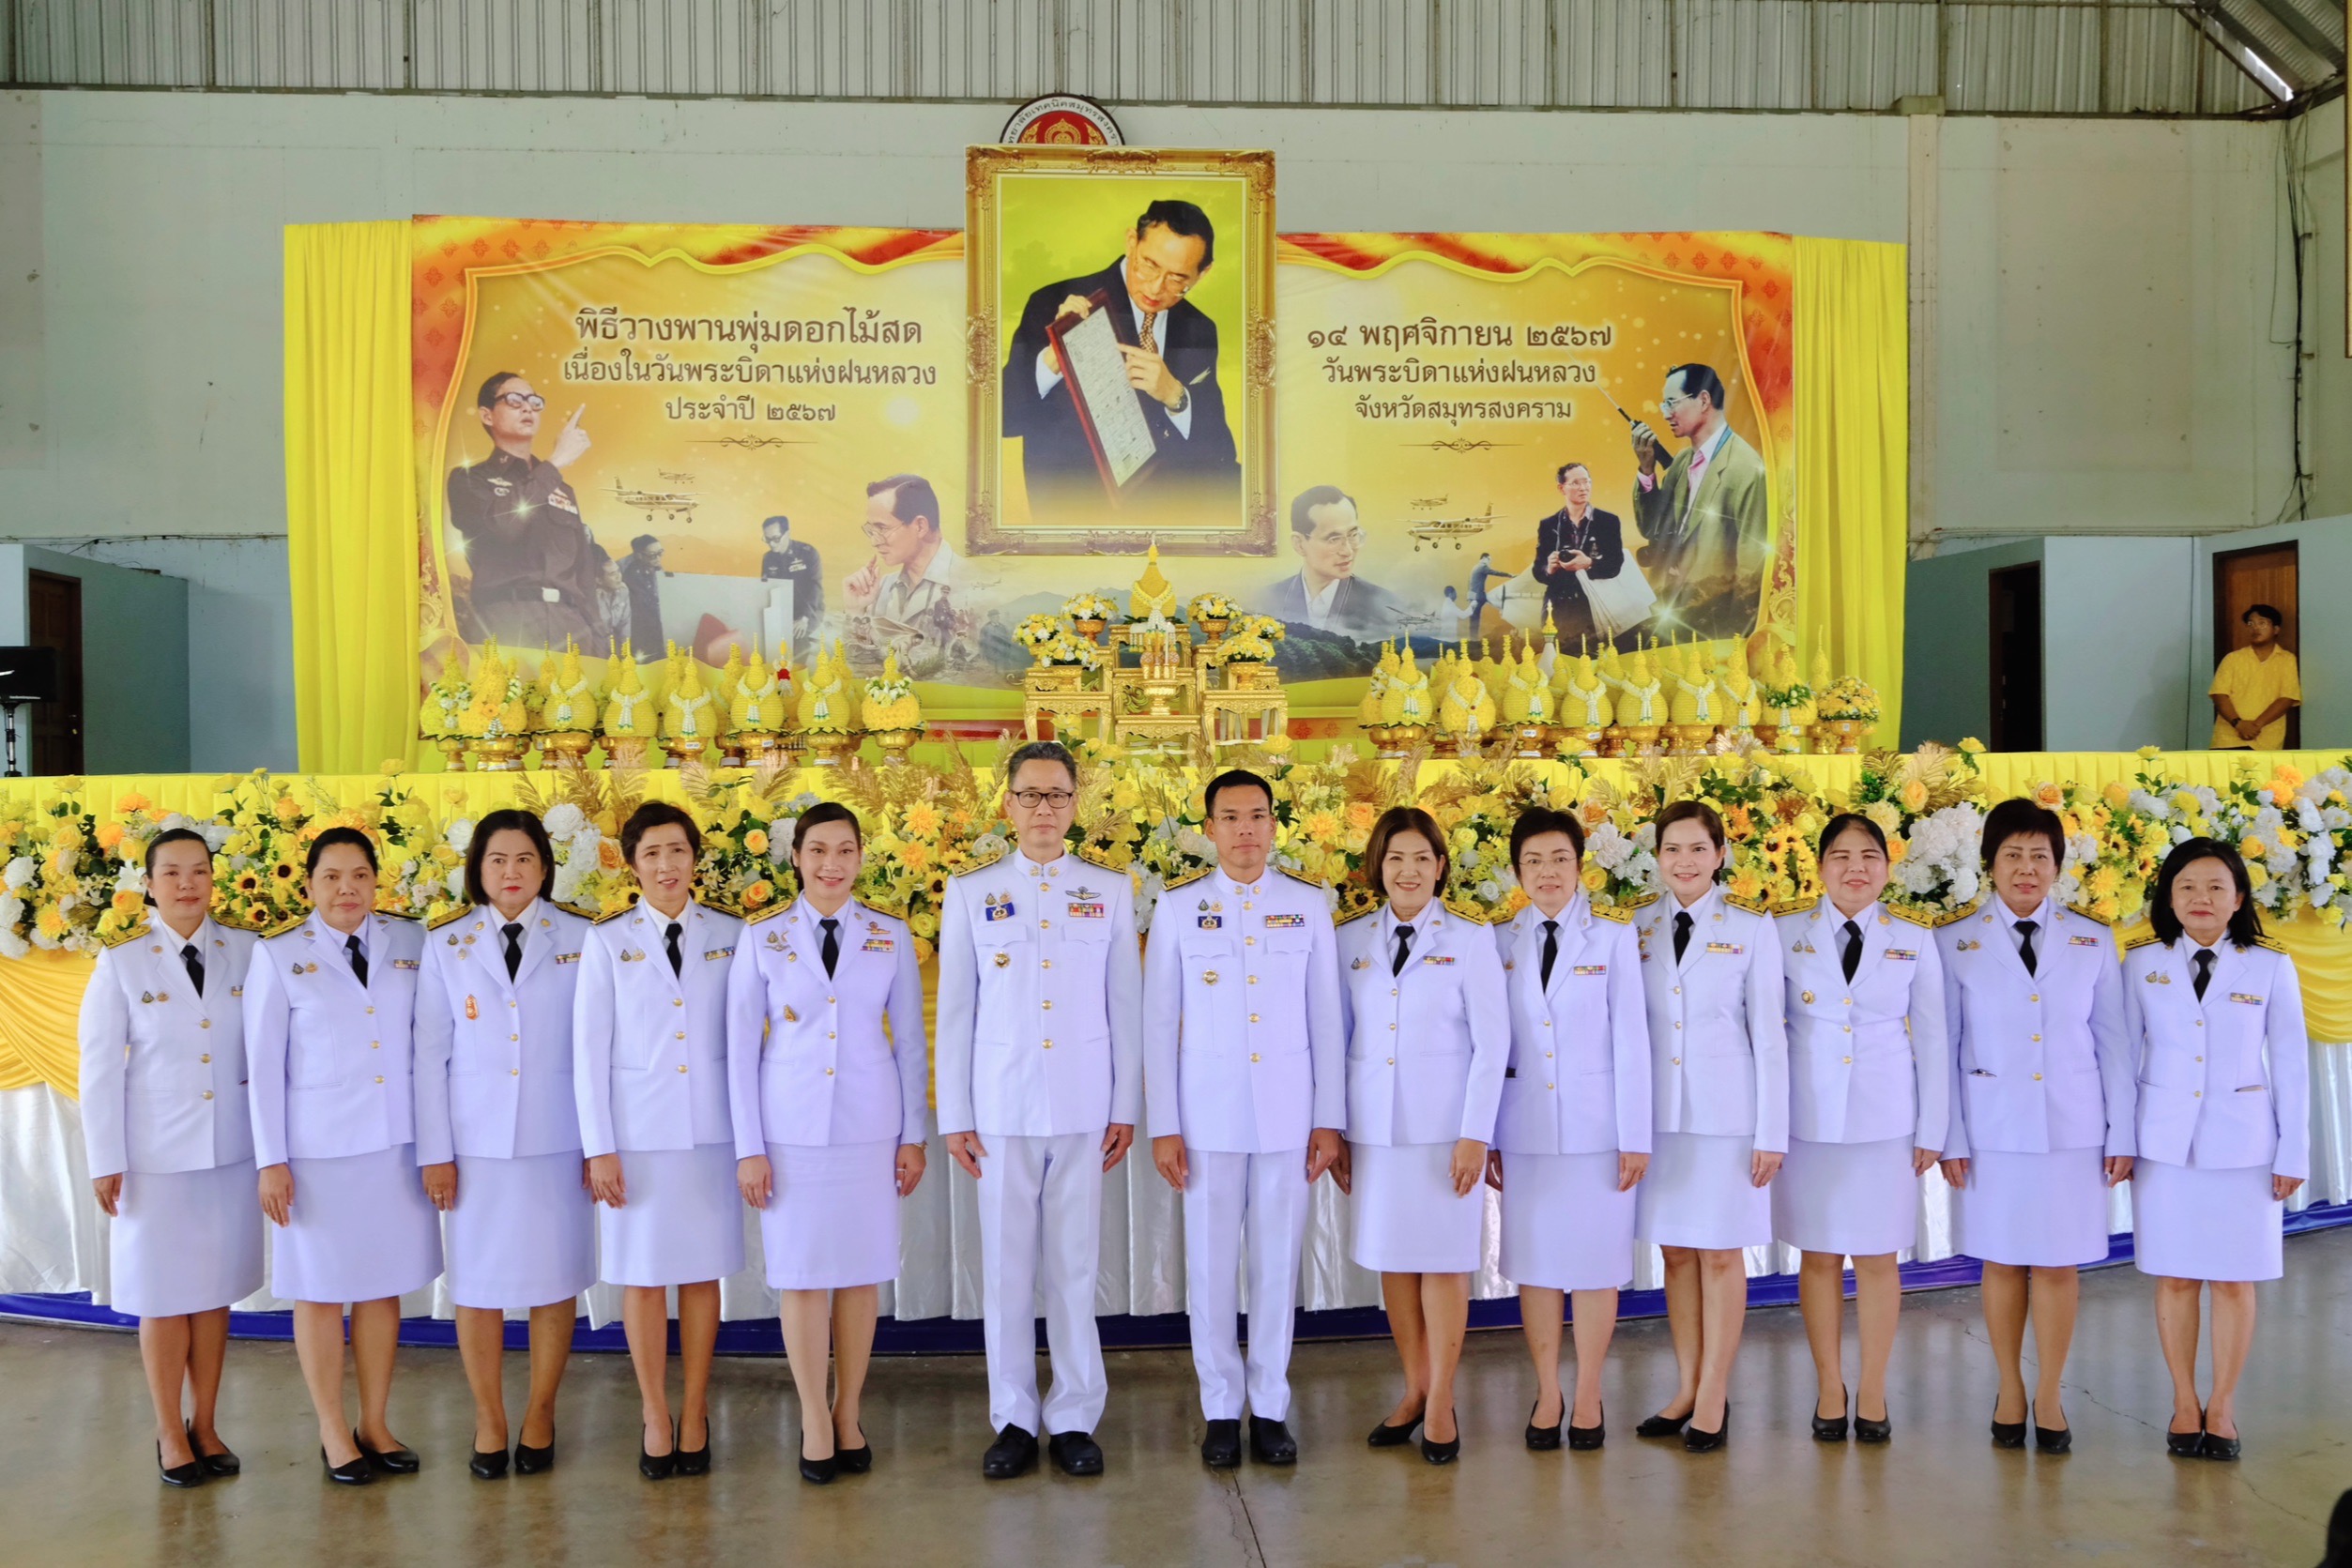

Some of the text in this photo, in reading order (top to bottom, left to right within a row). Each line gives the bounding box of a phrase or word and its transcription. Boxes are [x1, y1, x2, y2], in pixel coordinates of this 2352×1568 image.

[574, 307, 923, 354] พิธีวางพานพุ่มดอกไม้สด
[1307, 316, 1611, 353] ๑๔ พฤศจิกายน ๒๕๖๗
[563, 346, 937, 386] เนื่องในวันพระบิดาแห่งฝนหลวง
[1321, 356, 1596, 383] วันพระบิดาแห่งฝนหลวง
[665, 395, 836, 421] ประจำปี ๒๕๖๗
[1354, 394, 1572, 427] จังหวัดสมุทรสงคราม
